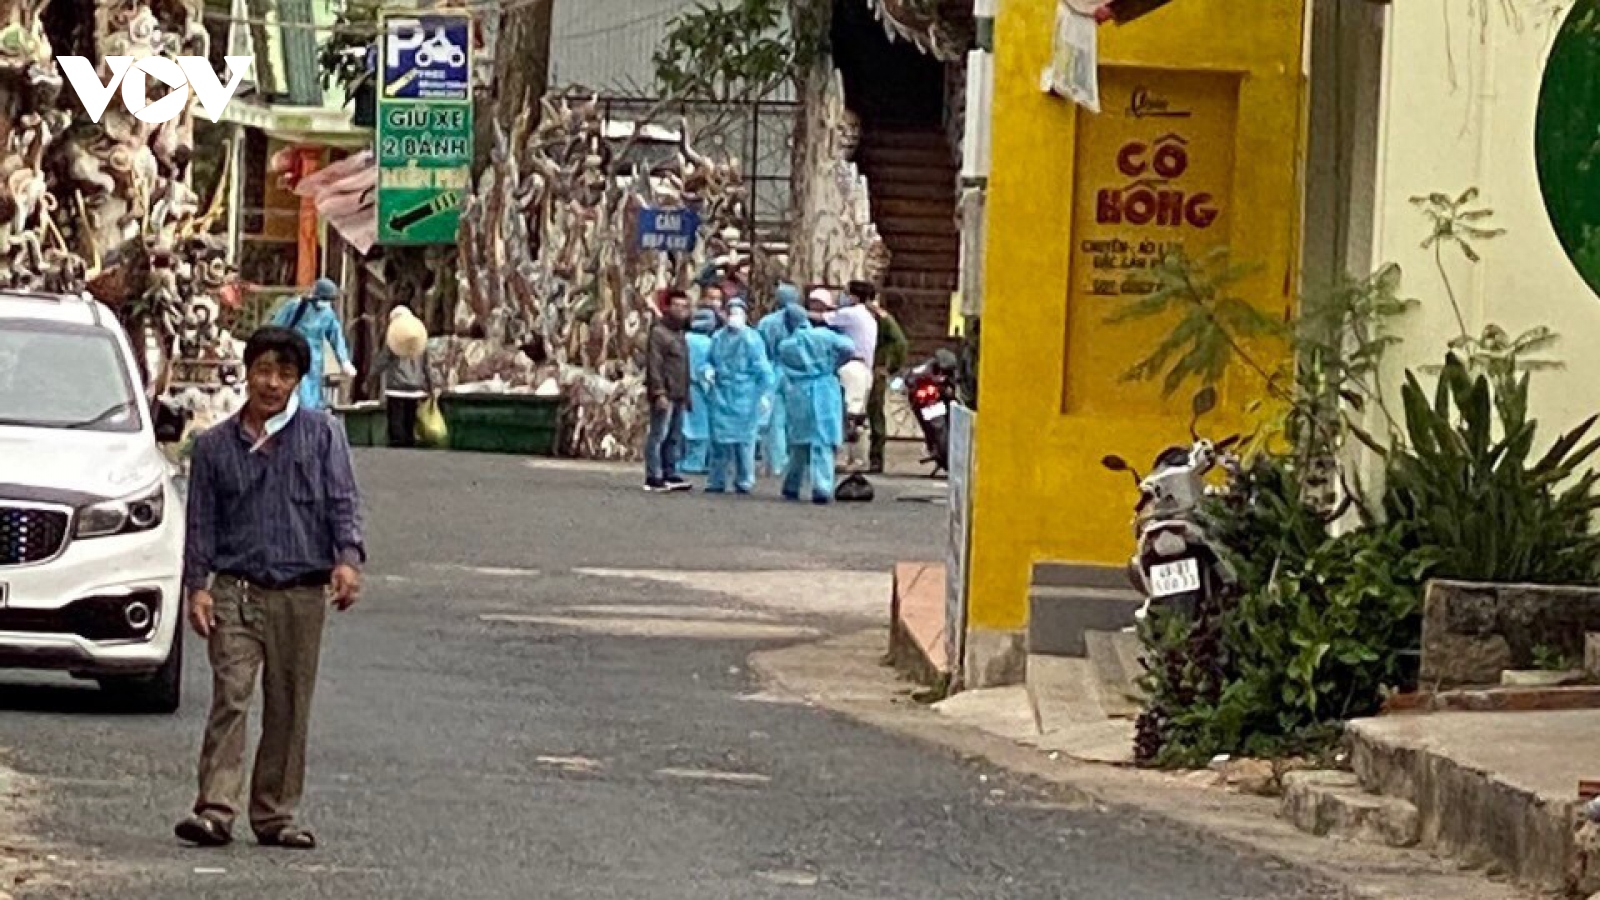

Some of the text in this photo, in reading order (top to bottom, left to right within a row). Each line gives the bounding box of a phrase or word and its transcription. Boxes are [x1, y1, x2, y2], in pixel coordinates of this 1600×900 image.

[387, 18, 425, 68] P
[434, 109, 463, 127] XE
[382, 136, 397, 156] 2
[1117, 132, 1188, 178] CÔ
